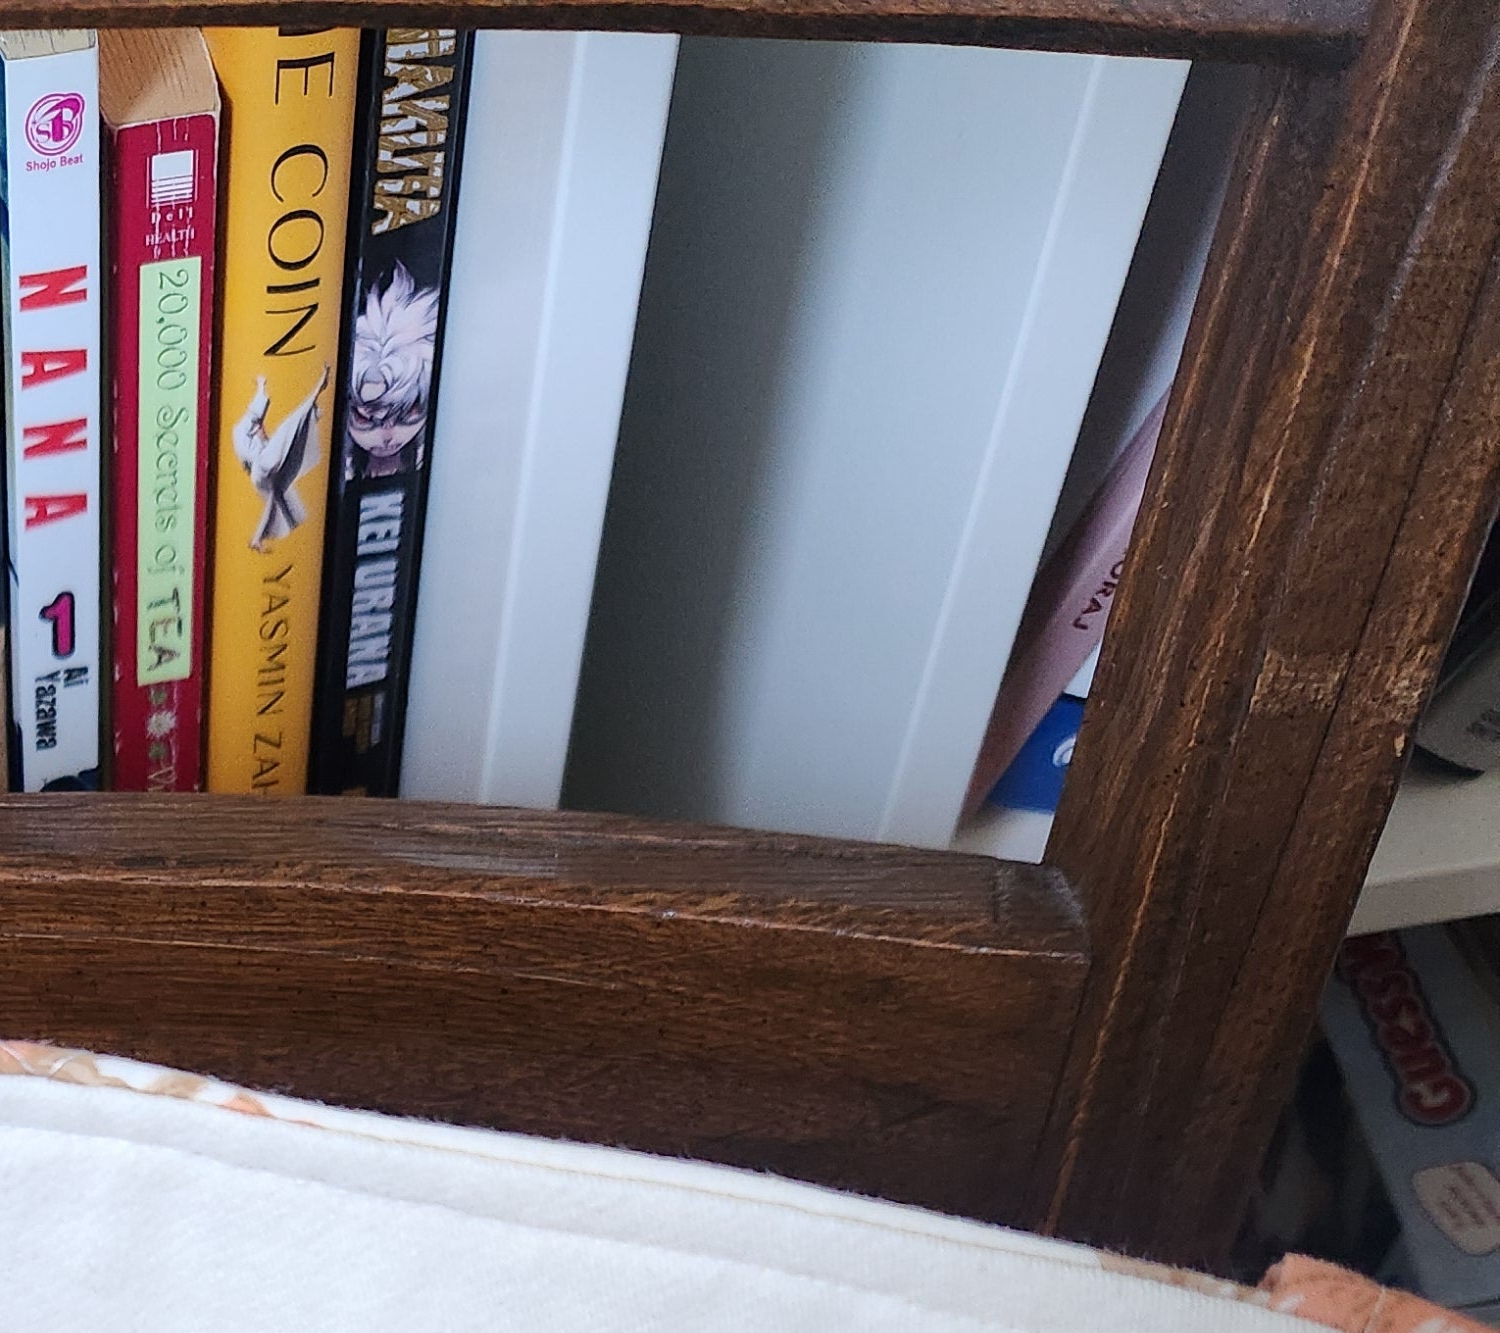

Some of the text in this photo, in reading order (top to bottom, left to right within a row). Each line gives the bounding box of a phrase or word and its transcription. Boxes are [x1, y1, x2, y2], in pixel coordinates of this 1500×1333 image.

[25, 153, 84, 173] Shojo Beat
[145, 227, 196, 247] HEALTH
[263, 143, 329, 357] COIN
[155, 268, 190, 391] 20,000
[18, 264, 88, 533] NANA
[37, 590, 76, 660] 1
[146, 586, 184, 673] TEA
[346, 490, 404, 690] KEI URANA
[62, 665, 90, 690] Ai
[257, 564, 294, 717] YASMIN
[34, 669, 63, 752] Yazawa
